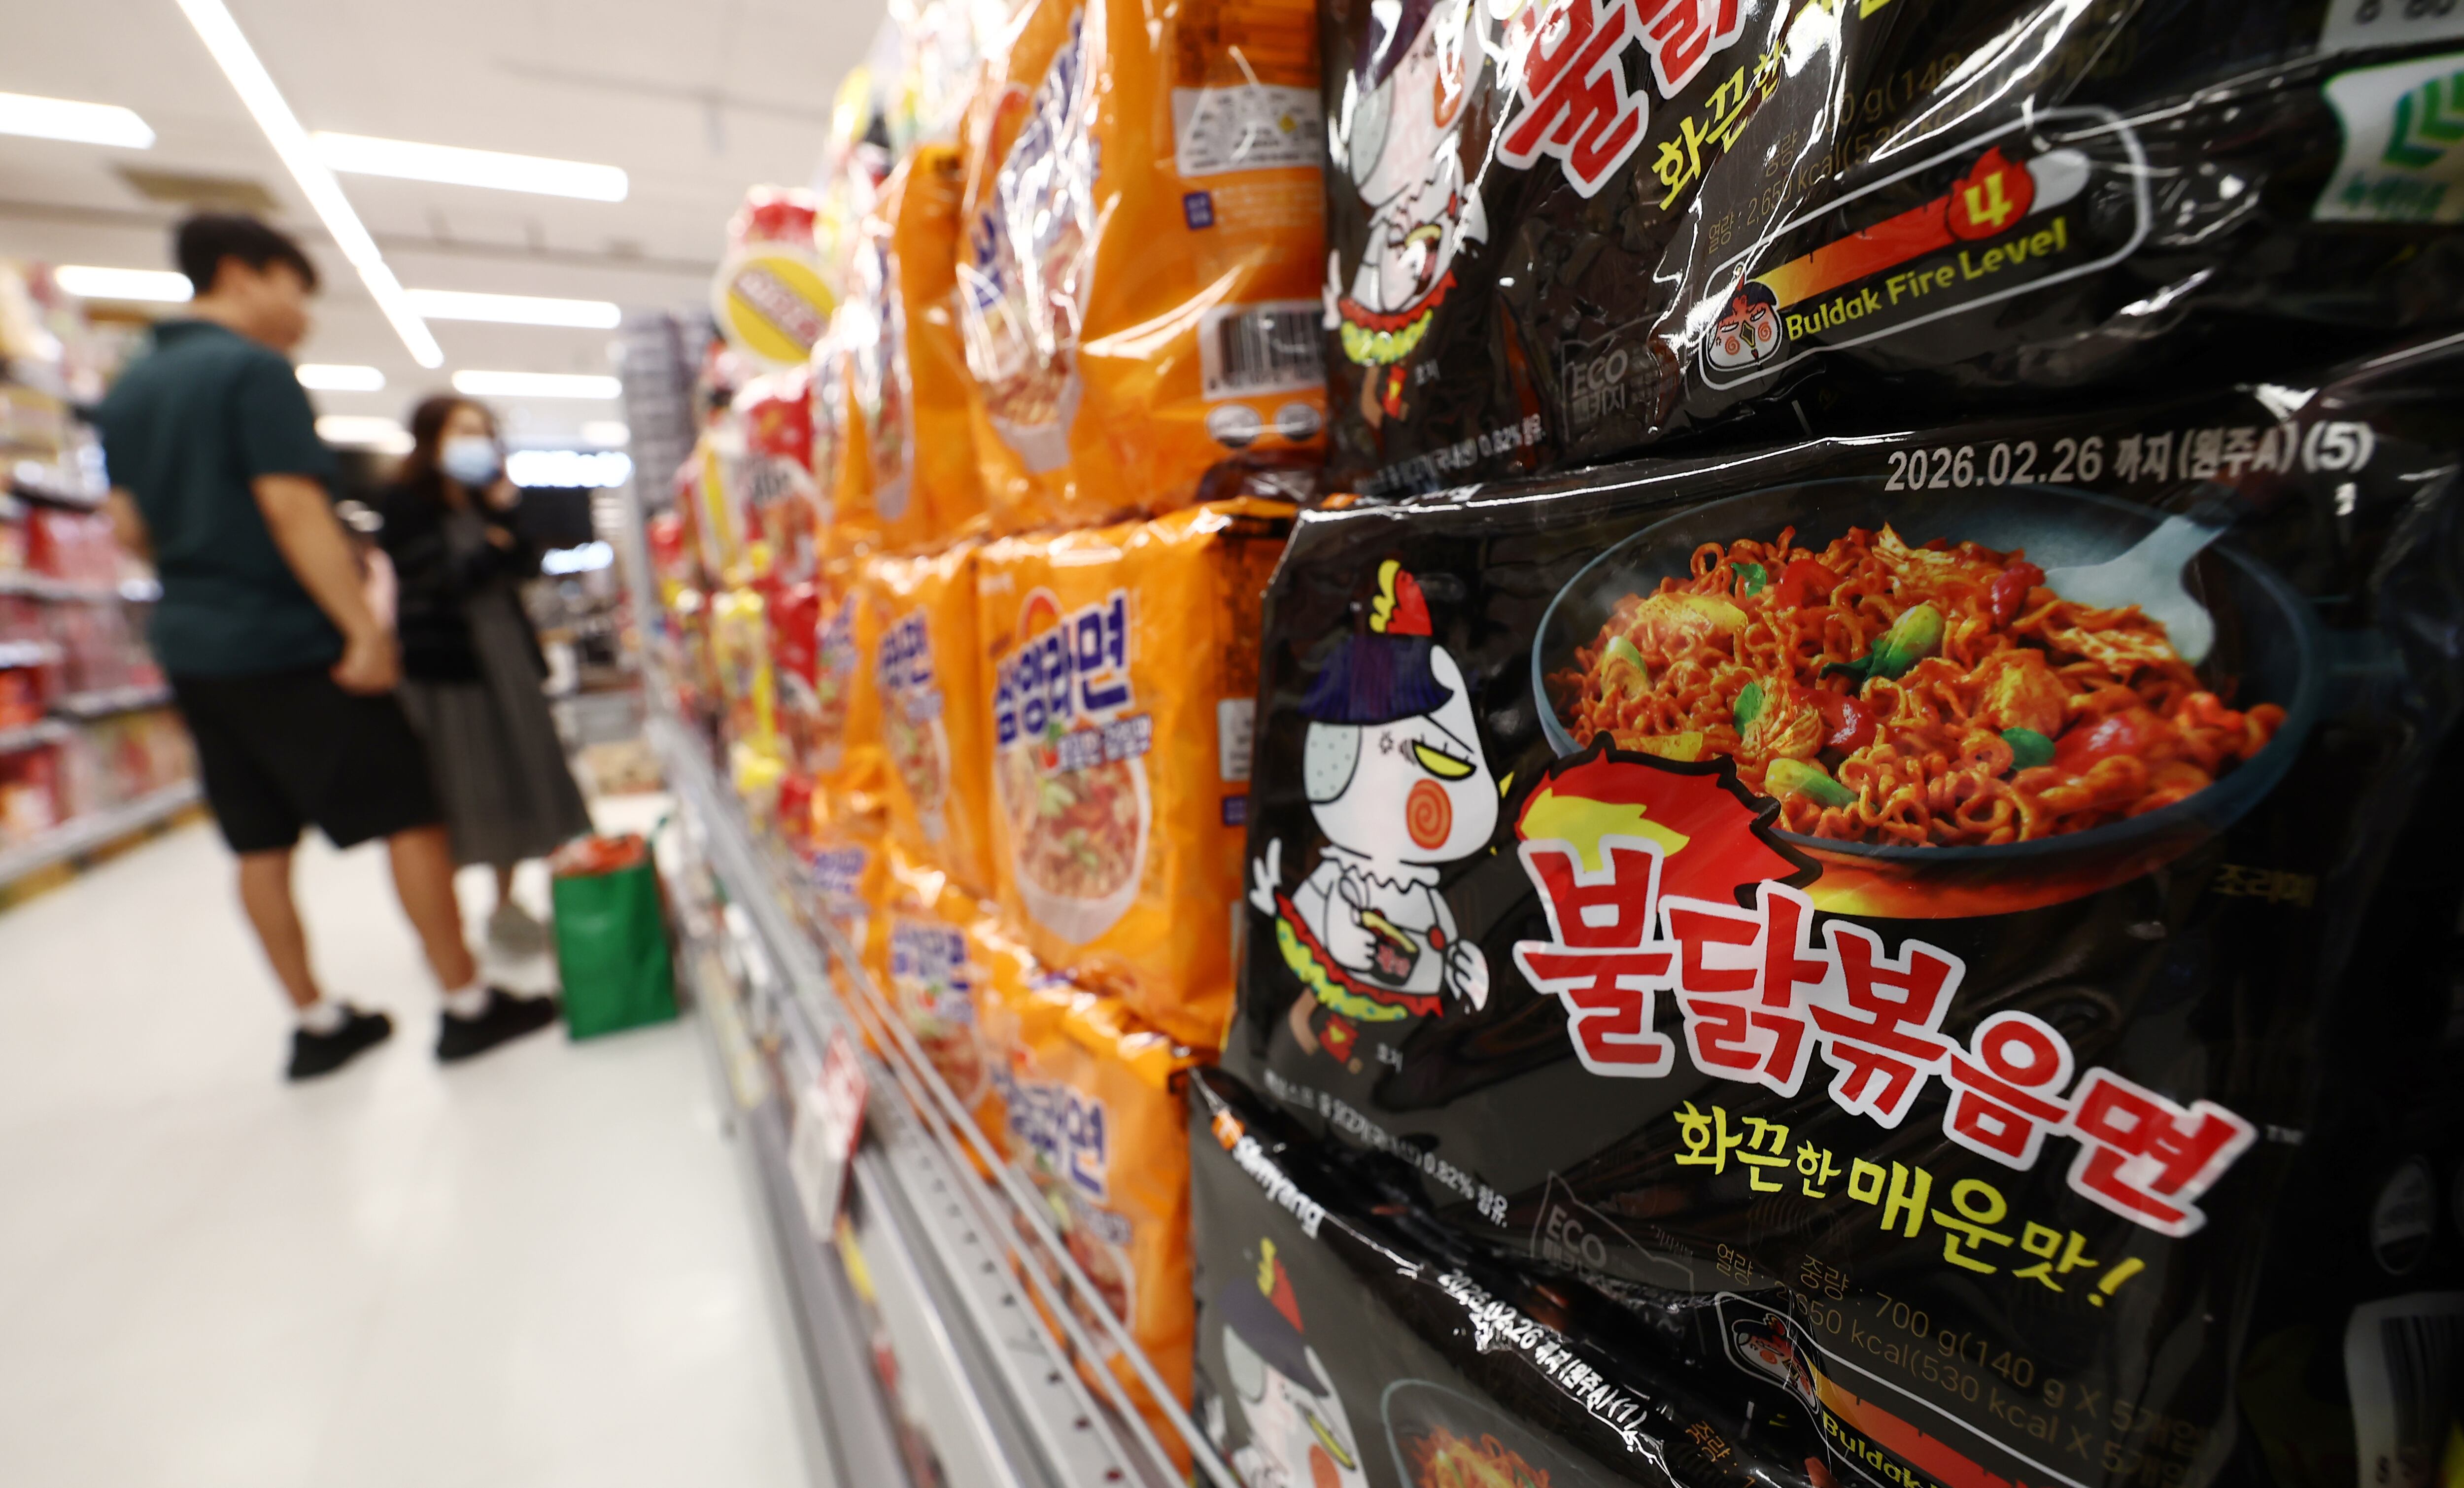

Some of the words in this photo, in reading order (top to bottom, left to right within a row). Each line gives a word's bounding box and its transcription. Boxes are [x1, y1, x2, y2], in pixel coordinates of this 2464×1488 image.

[1963, 172, 2012, 227] 4
[1708, 212, 1734, 253] 열량
[1784, 292, 1882, 342] Buldak
[1885, 263, 1955, 307] Fire
[1958, 216, 2067, 281] Level
[1570, 349, 1628, 398] ECO
[1884, 437, 2104, 492] 2026.02.26
[1512, 833, 2258, 1238] 불닭볶음면
[1674, 1101, 1841, 1199] 화끈한
[1848, 1160, 2145, 1308] 매운맛!
[1546, 1204, 1607, 1269] ECO
[1716, 1243, 1753, 1286] 열량
[1801, 1254, 1849, 1301] 중량
[1876, 1291, 1929, 1338] 700
